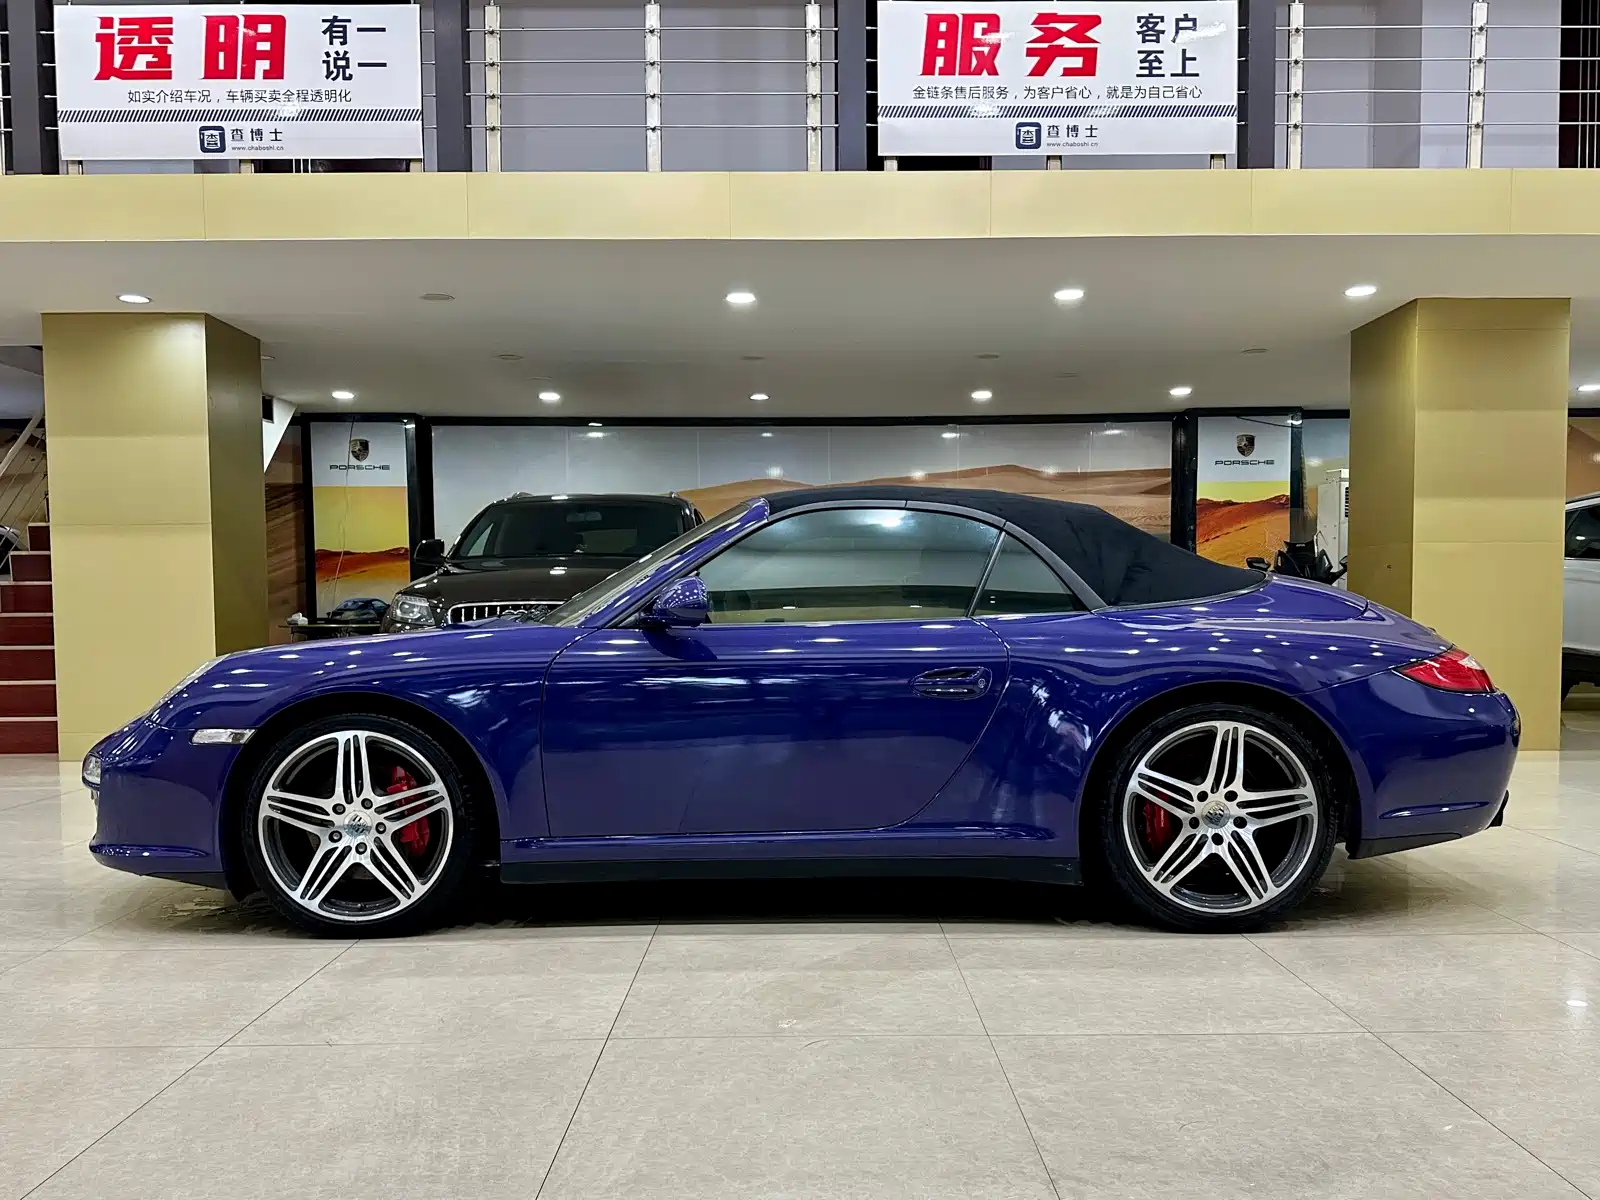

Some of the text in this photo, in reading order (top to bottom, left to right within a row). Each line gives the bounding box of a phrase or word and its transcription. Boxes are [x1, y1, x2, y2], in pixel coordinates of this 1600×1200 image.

[321, 15, 387, 46] 有一
[1136, 13, 1198, 44] 客户
[94, 14, 287, 81] 透明
[919, 12, 1102, 77] 服务
[321, 50, 388, 82] 说一
[1135, 49, 1200, 78] 至上
[912, 85, 1203, 100] 金链条售后服务，为客户省心，就是为自己省心
[230, 128, 283, 142] 查博士
[1046, 124, 1099, 139] 查博士
